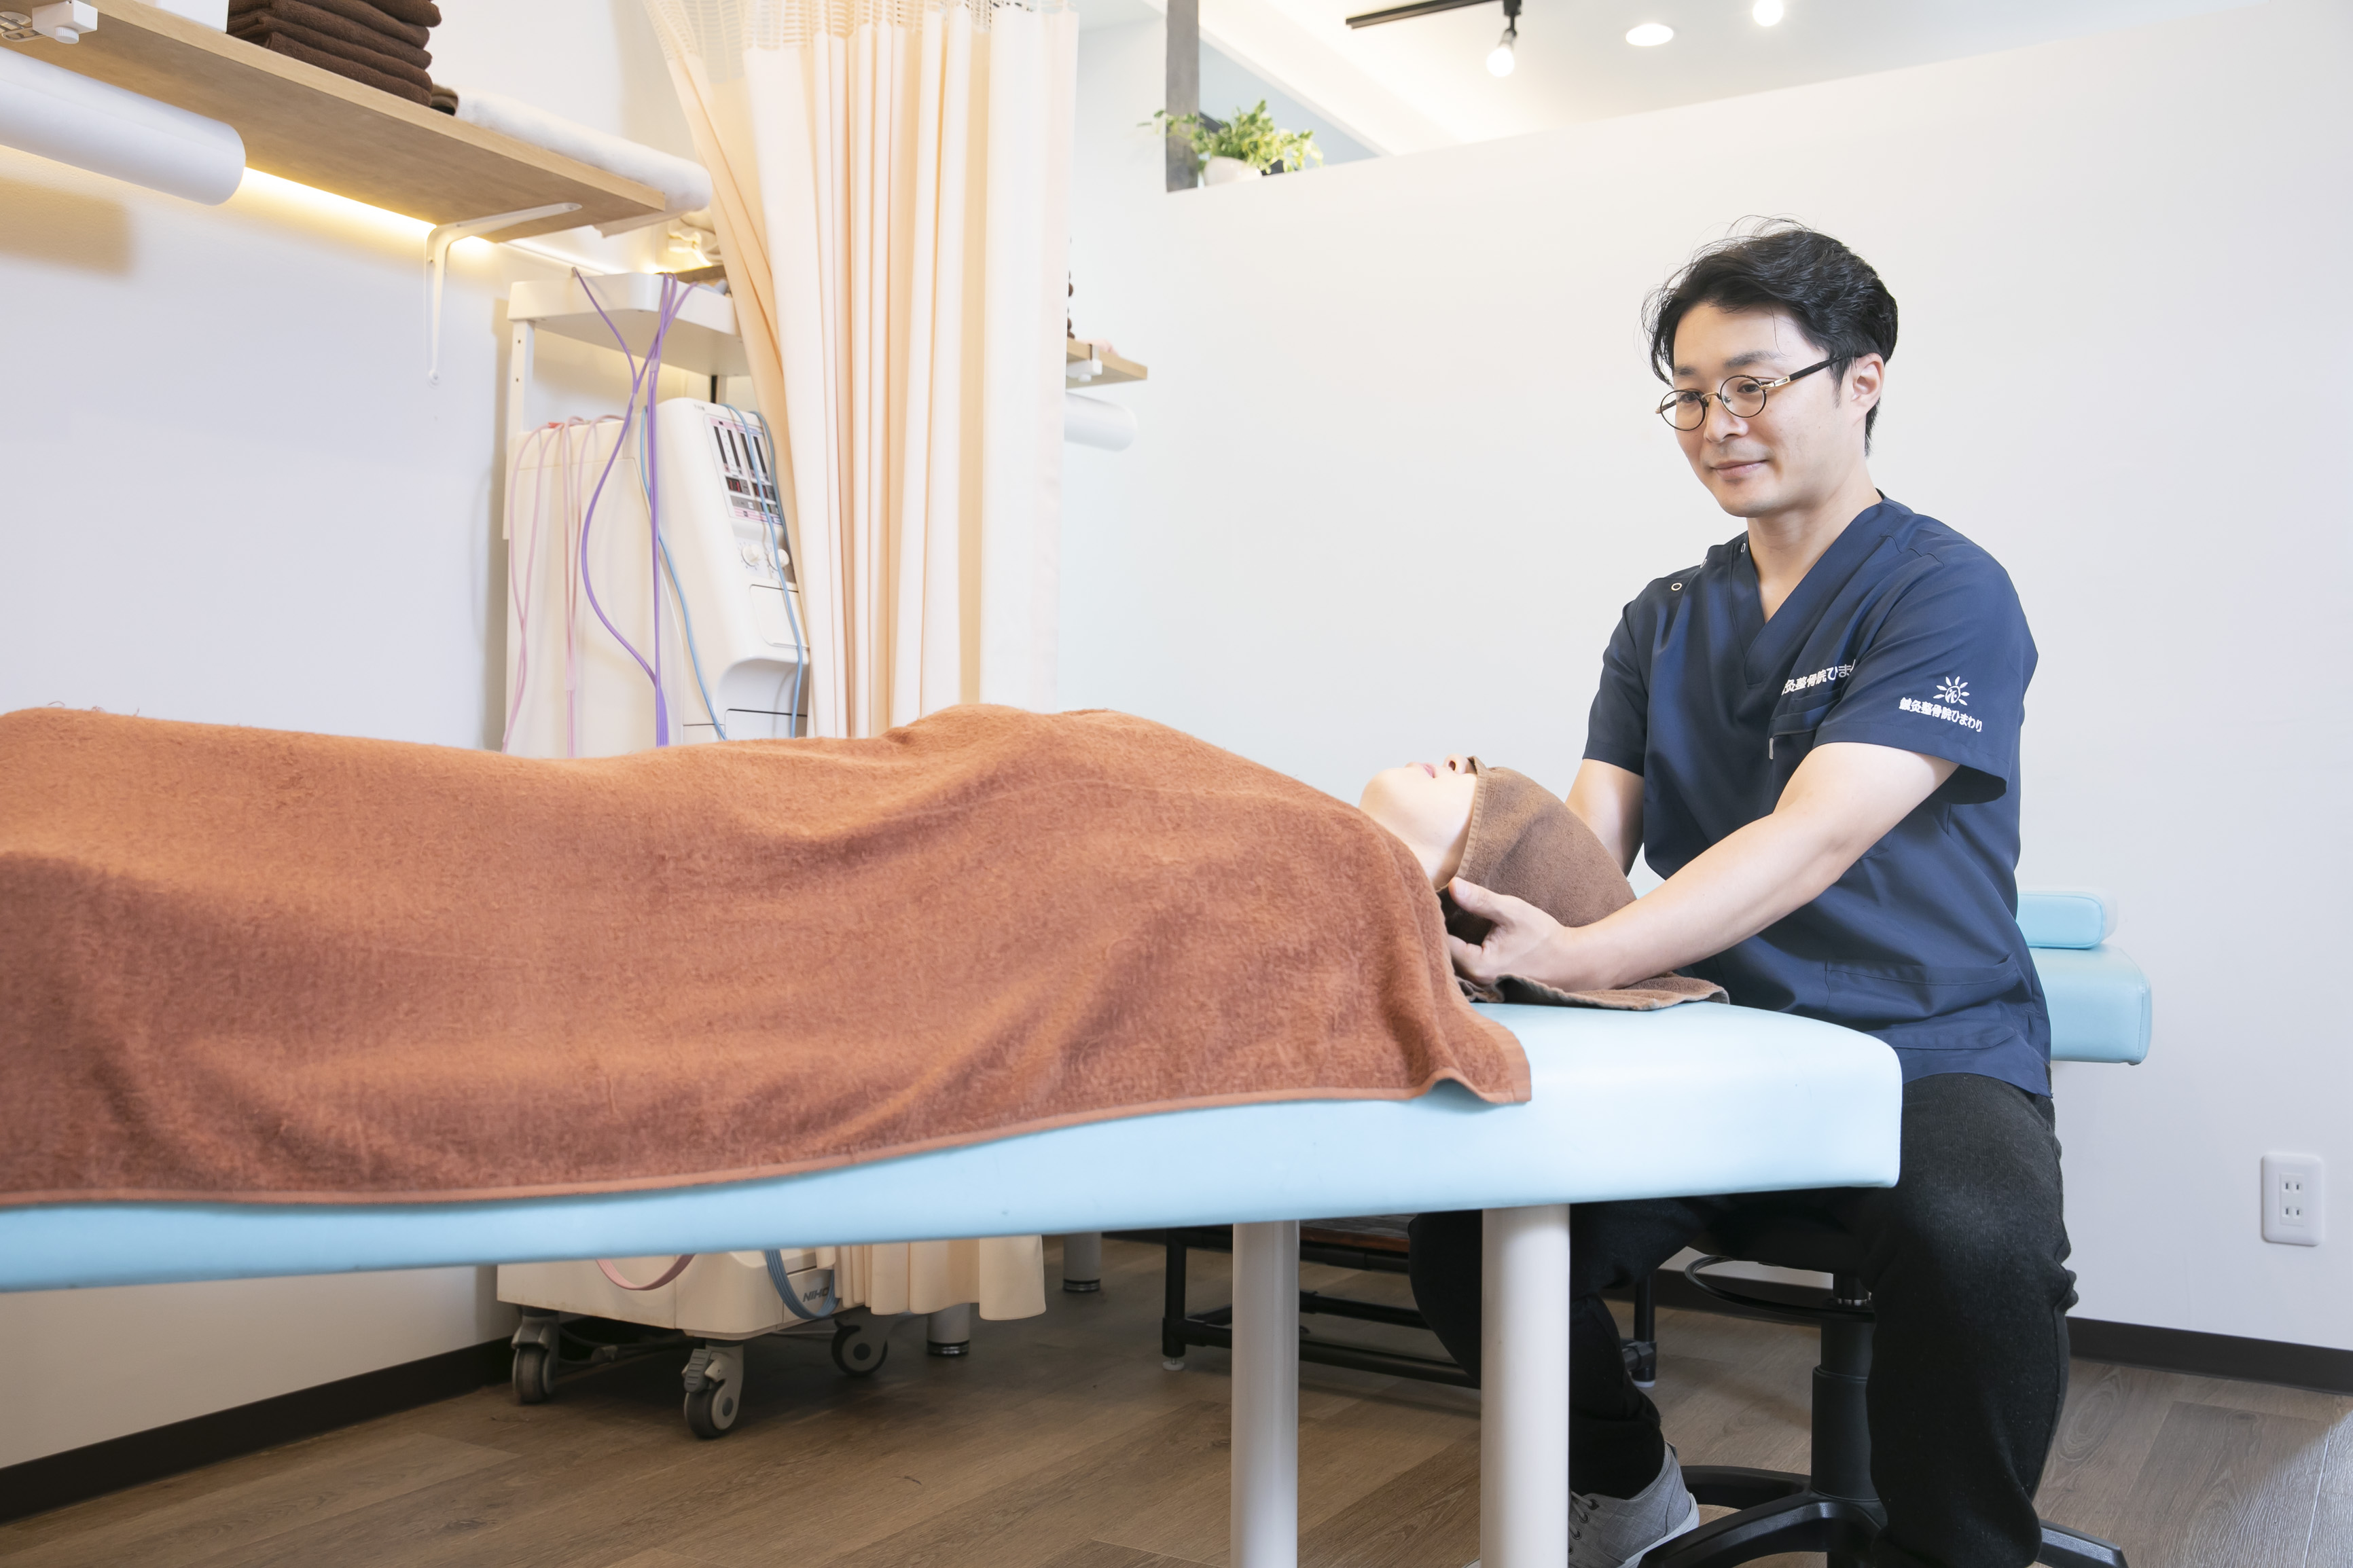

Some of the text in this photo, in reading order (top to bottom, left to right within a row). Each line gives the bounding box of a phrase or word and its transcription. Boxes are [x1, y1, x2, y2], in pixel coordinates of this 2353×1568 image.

[1781, 659, 1856, 696] 灸整骨院ひま
[1899, 697, 1983, 733] 鍼灸整骨院ひまわり
